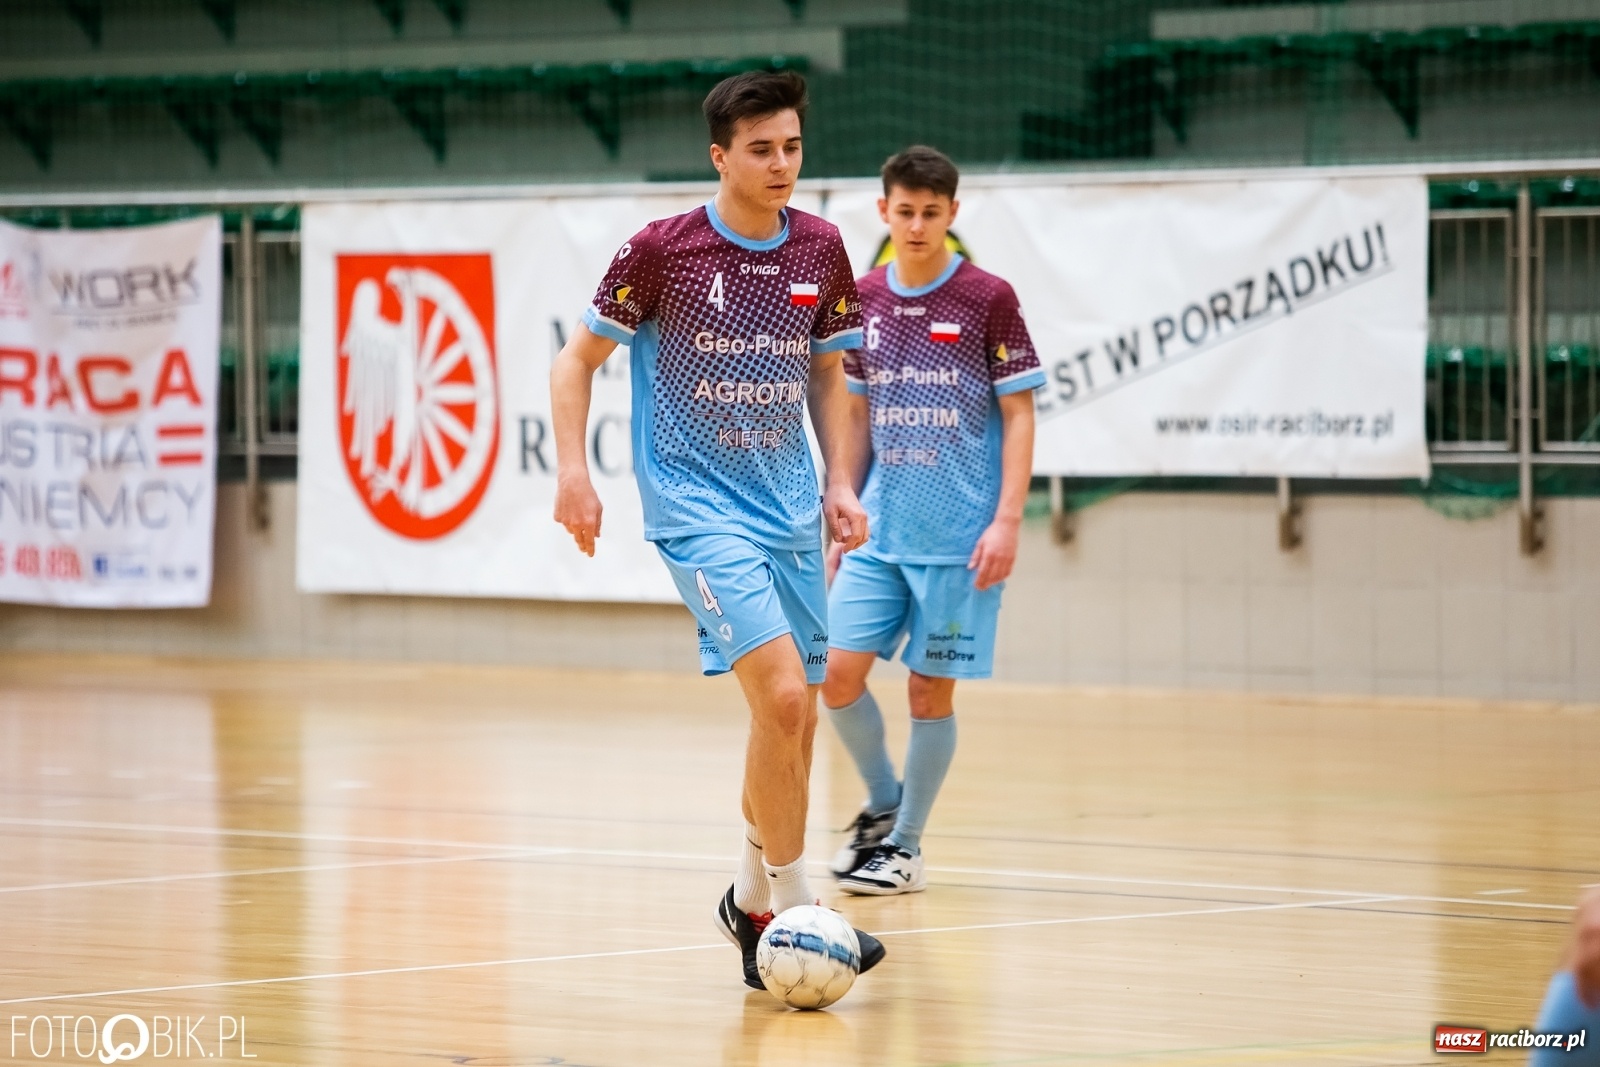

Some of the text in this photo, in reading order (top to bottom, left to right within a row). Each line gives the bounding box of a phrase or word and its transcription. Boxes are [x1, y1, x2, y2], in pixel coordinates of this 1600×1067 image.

[48, 258, 202, 311] WORK
[751, 264, 780, 276] VIGO
[707, 272, 725, 312] 4
[1103, 329, 1141, 376] W
[1152, 222, 1391, 358] PORZĄDKU!
[866, 316, 882, 350] 6
[694, 378, 805, 405] AGROTIM
[694, 568, 724, 618] 4
[926, 649, 976, 662] Int-Drew
